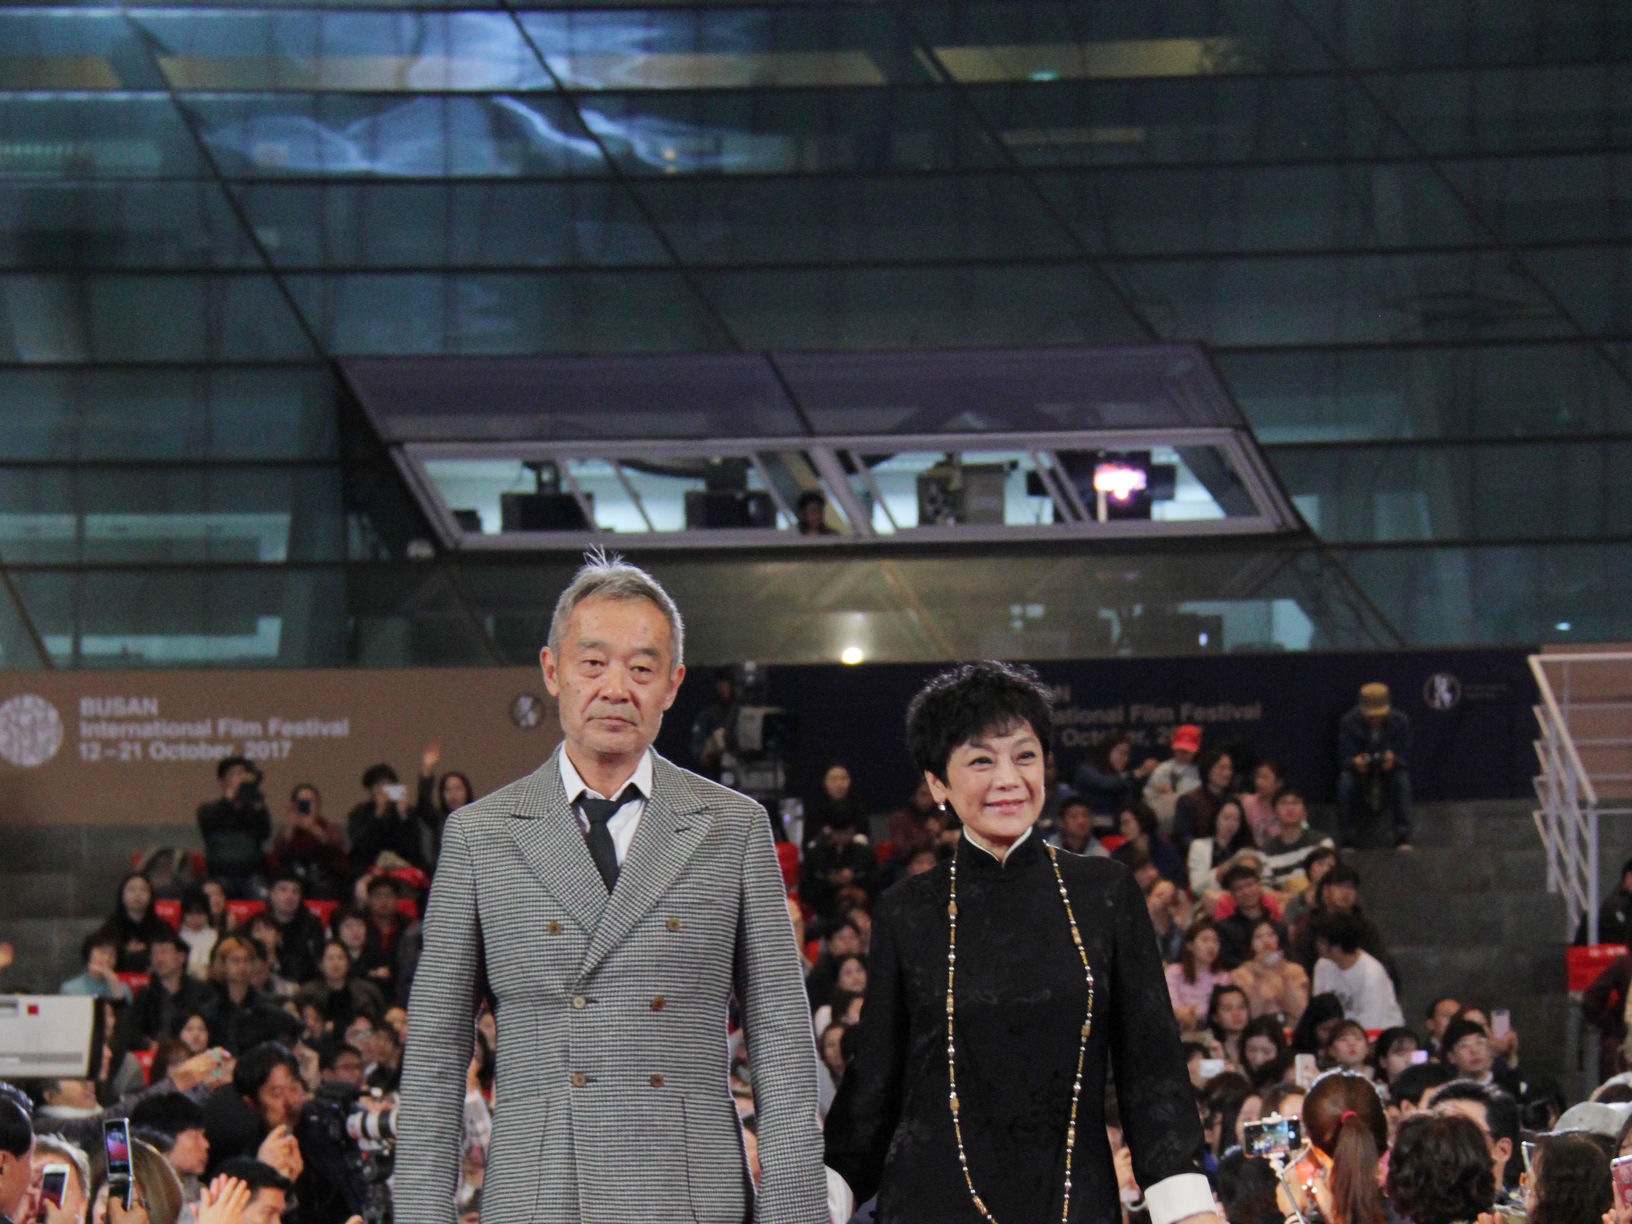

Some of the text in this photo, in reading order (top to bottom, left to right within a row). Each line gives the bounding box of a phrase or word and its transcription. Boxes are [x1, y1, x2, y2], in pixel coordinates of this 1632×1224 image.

[80, 697, 158, 716] BUSAN
[80, 717, 350, 737] International Film Festival
[243, 740, 292, 759] 2017
